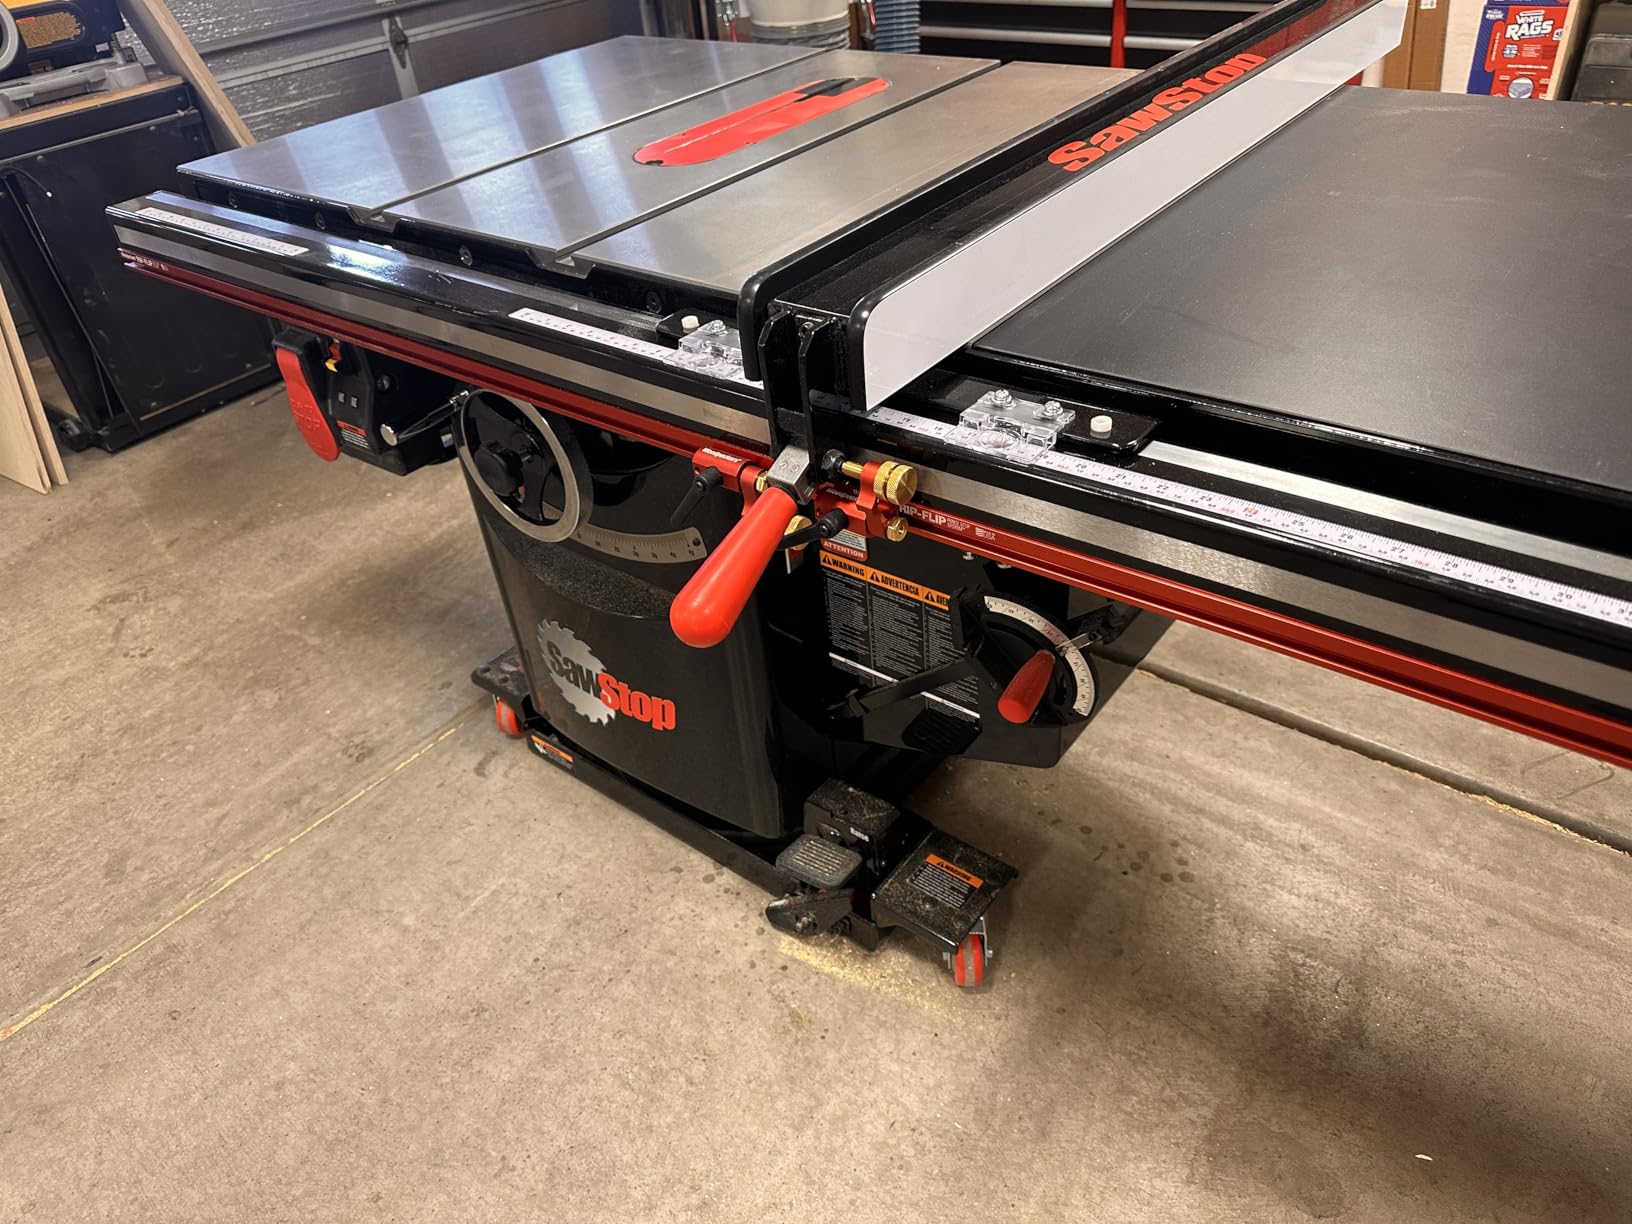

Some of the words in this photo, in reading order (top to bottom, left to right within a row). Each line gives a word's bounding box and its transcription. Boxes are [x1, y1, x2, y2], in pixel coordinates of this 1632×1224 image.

[1505, 20, 1554, 40] RAGS
[1516, 15, 1544, 25] WHITE
[1048, 53, 1267, 172] SawStop
[823, 541, 864, 558] ATTENTION
[831, 559, 865, 577] WARNING
[881, 575, 920, 596] ADVERTENCIA
[546, 640, 676, 731] SawStop
